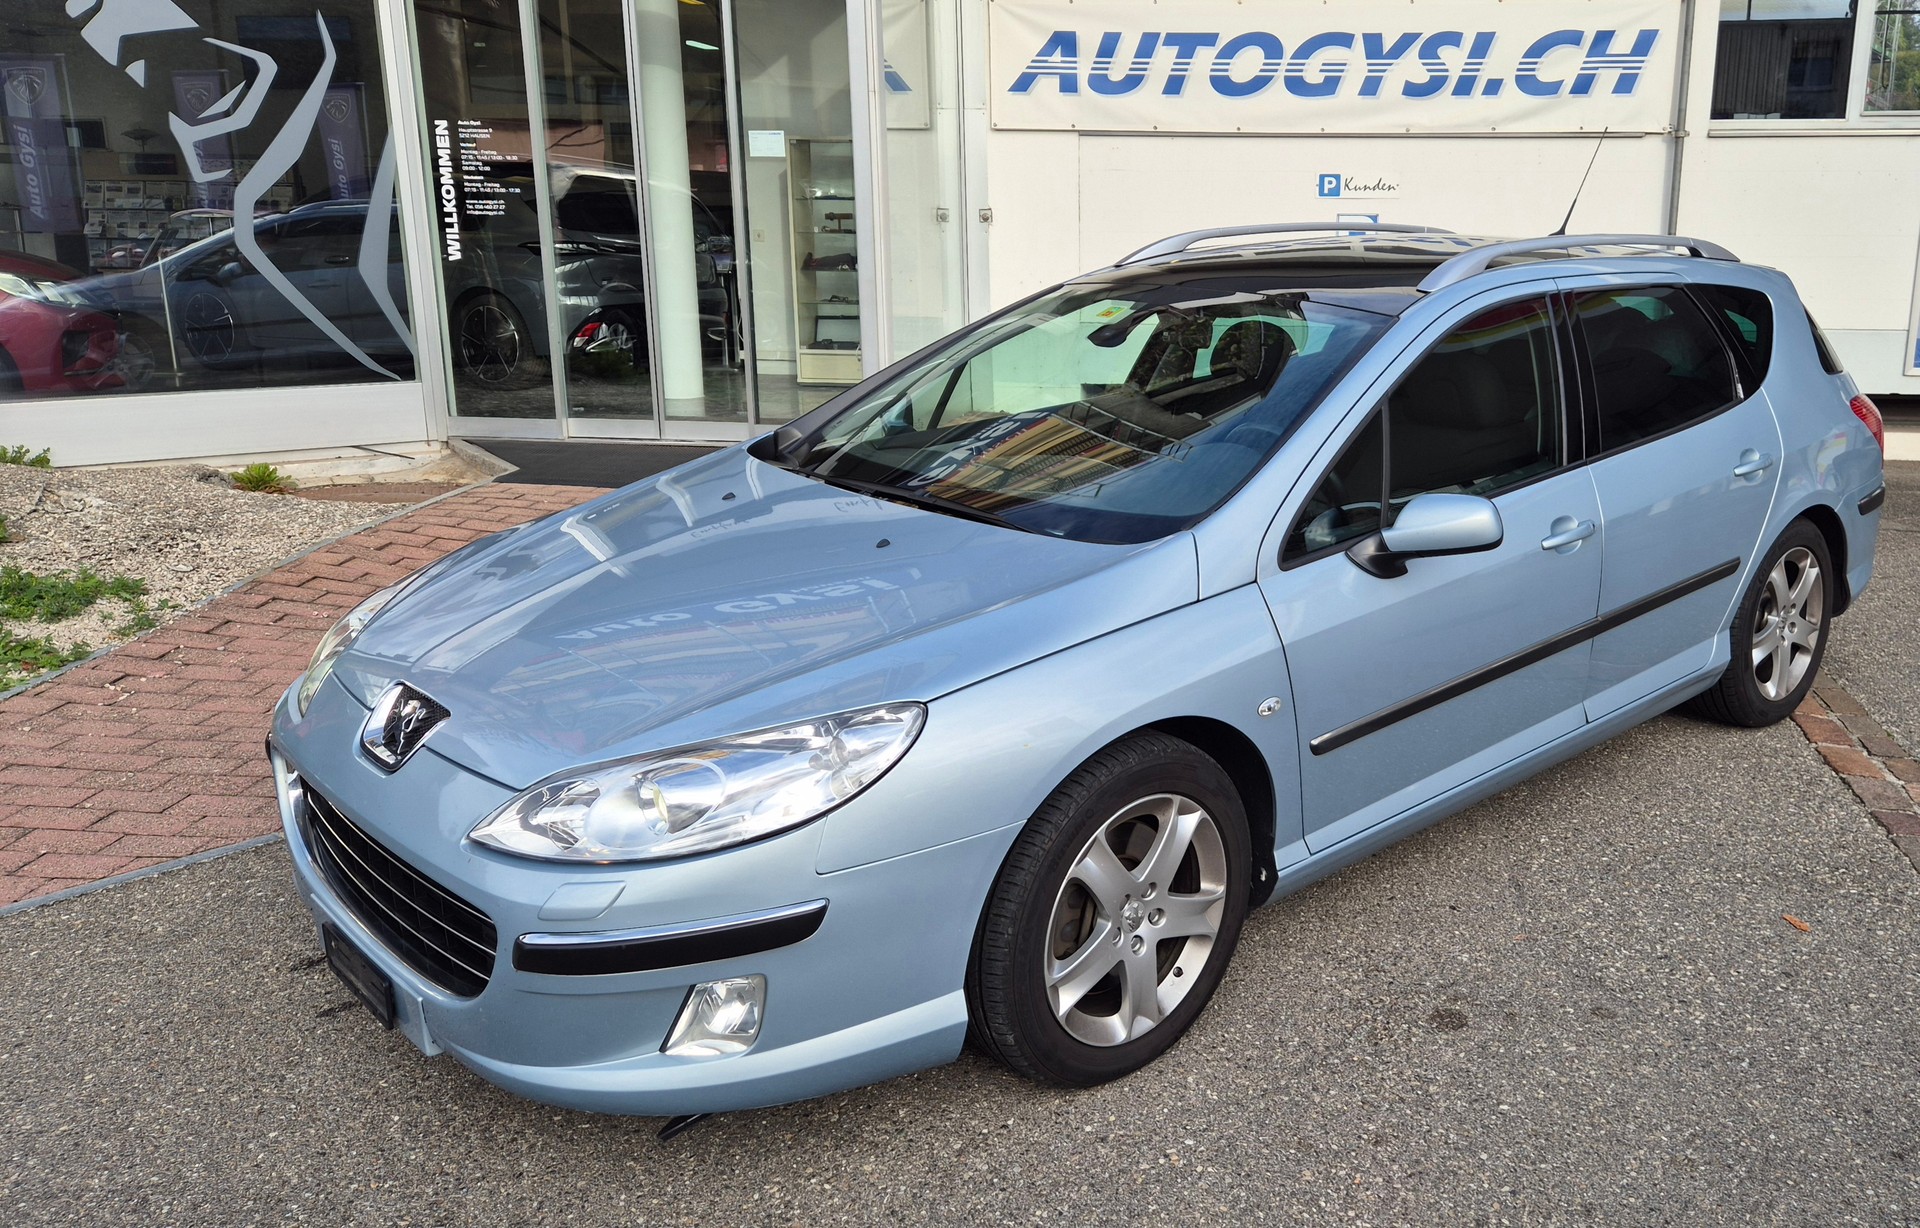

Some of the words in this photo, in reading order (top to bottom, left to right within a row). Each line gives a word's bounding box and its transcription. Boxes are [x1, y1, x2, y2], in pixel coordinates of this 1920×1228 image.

[1007, 28, 1661, 98] AUTOGYSI.CH
[13, 124, 36, 168] Gysi
[328, 138, 346, 170] Gysi
[27, 174, 44, 219] Auto
[336, 174, 350, 201] uto
[434, 120, 462, 261] WILLKOMMEN
[1343, 176, 1396, 192] Kunden
